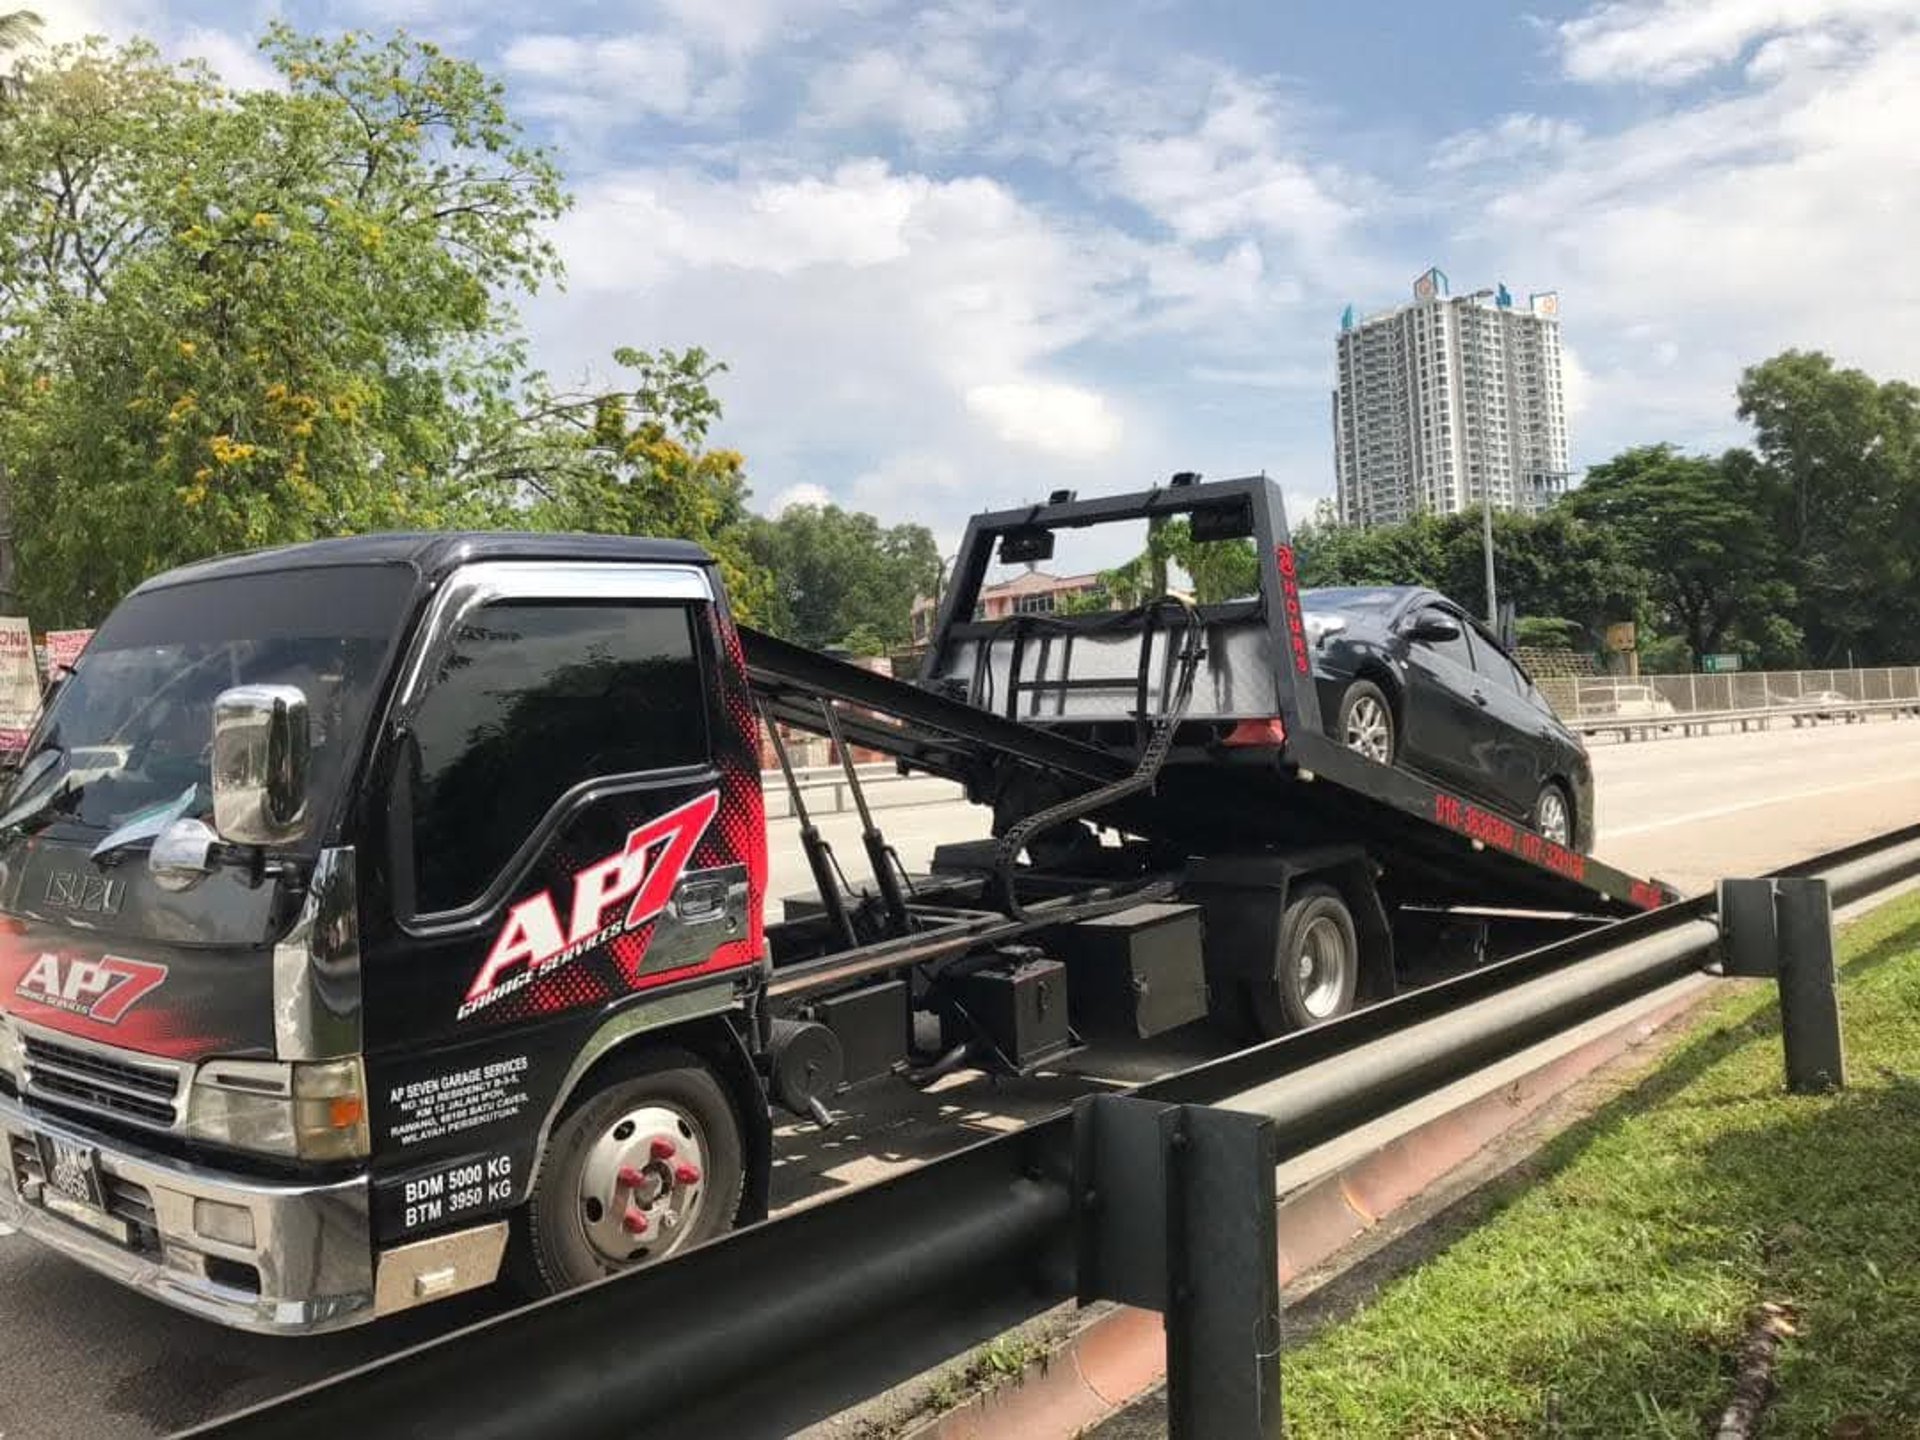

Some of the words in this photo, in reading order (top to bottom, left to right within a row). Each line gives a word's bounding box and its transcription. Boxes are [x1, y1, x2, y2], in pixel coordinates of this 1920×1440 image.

[43, 871, 127, 914] ISUZU
[466, 788, 720, 1001] AP7
[537, 920, 622, 978] SERVICES
[20, 952, 169, 1025] AP7
[390, 1087, 404, 1103] AP
[406, 1080, 439, 1098] SEVEN
[441, 1068, 482, 1089] GARAGE
[483, 1056, 528, 1079] SERVICES
[448, 1094, 479, 1110] JALAN
[469, 1101, 495, 1116] BATU
[405, 1174, 444, 1203] BDM
[449, 1164, 483, 1190] 5000
[488, 1156, 511, 1180] KG
[406, 1199, 442, 1227] BTM
[449, 1187, 483, 1212] 3950
[488, 1179, 511, 1202] KG
